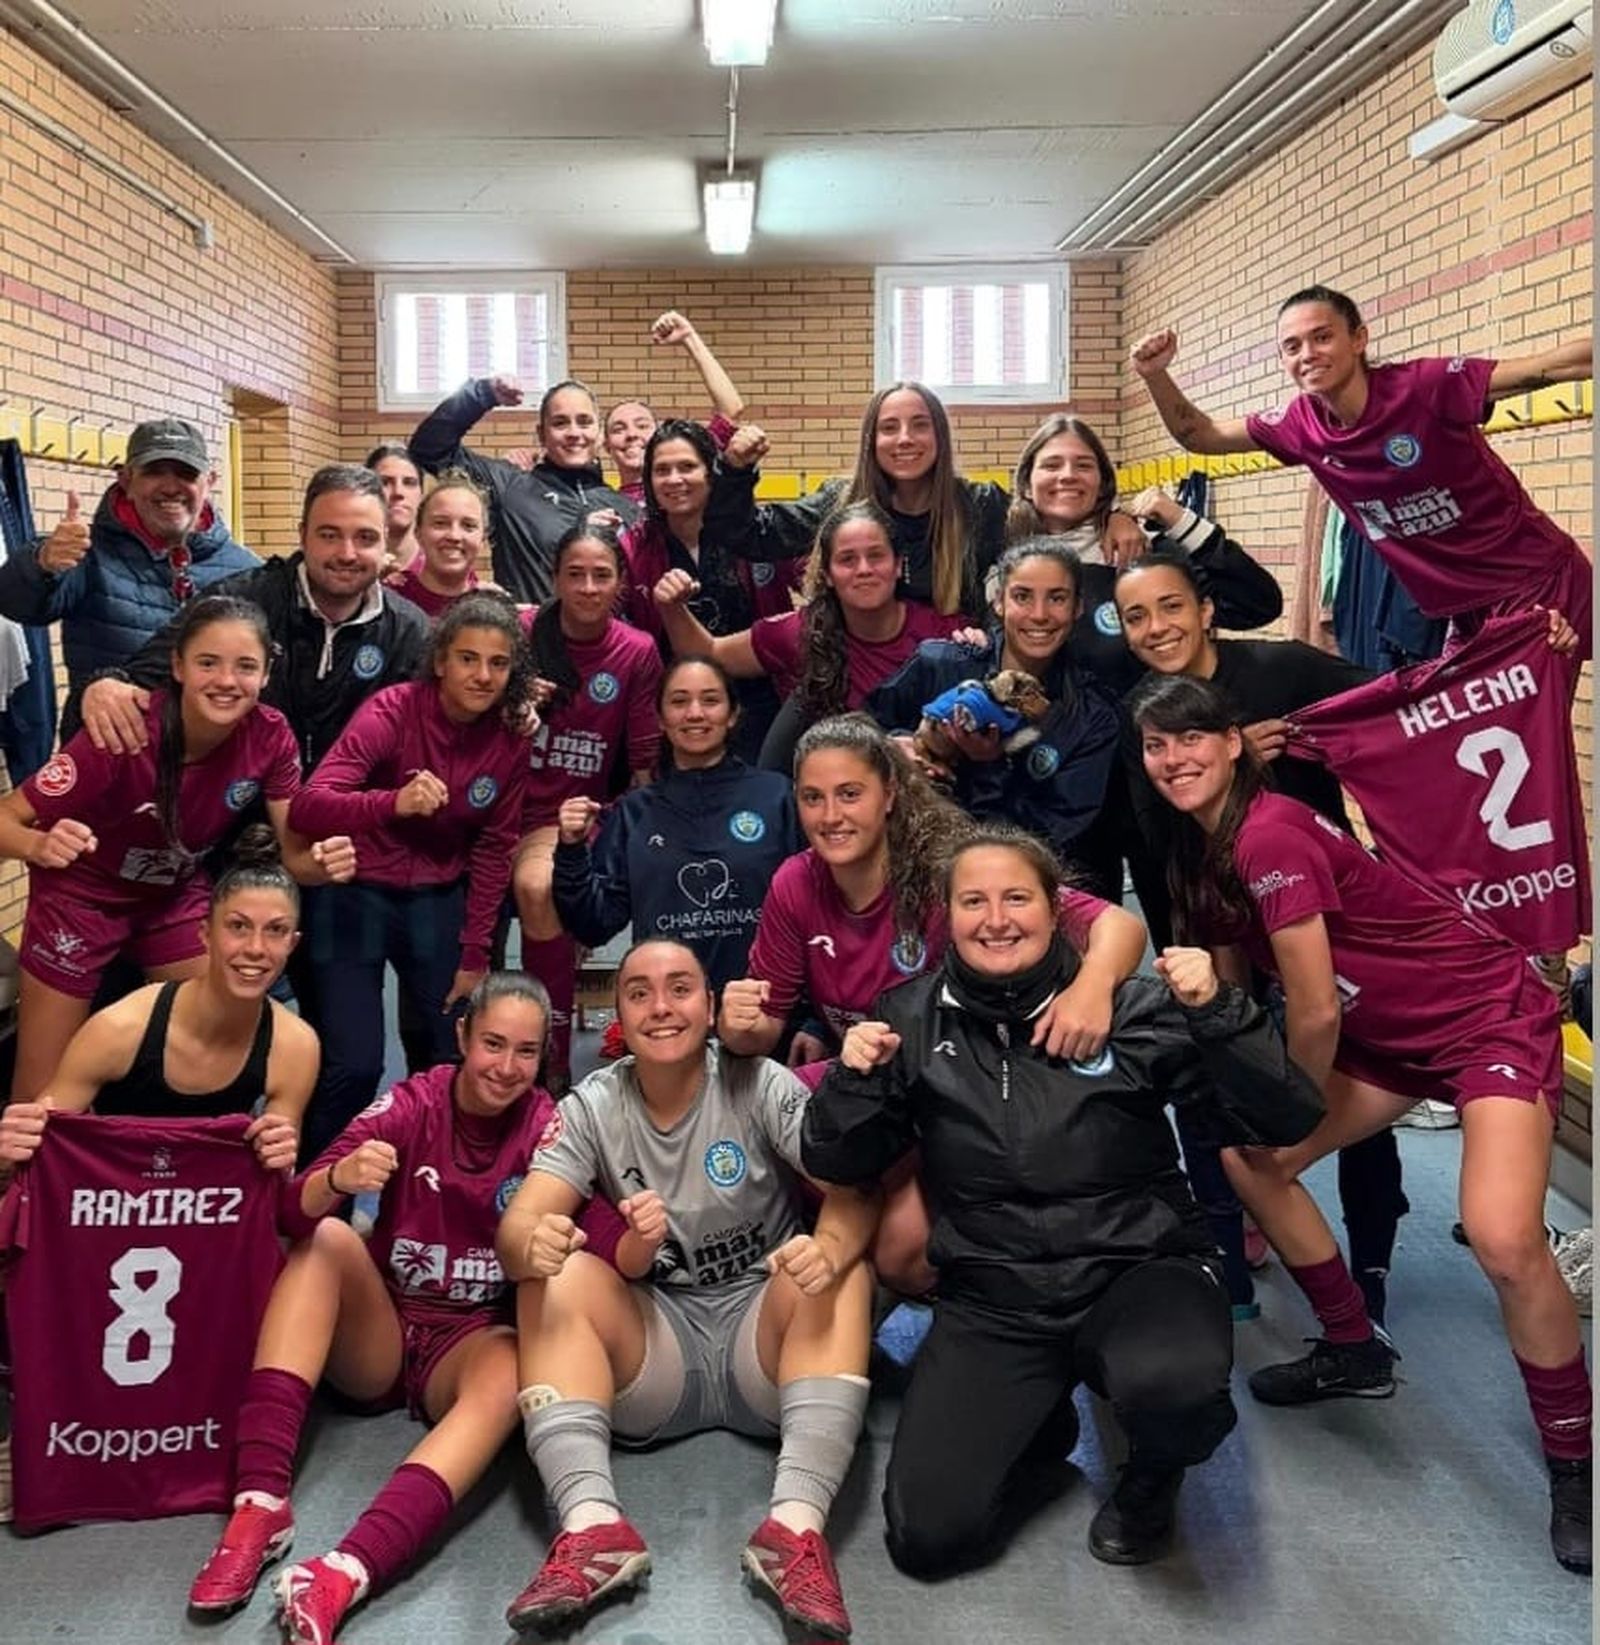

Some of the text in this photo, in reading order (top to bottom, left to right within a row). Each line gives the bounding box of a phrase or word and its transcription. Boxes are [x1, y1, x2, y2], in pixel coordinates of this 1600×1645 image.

[1392, 487, 1451, 521] mar
[1401, 498, 1463, 536] azul
[1396, 663, 1539, 738] HELENA
[547, 751, 603, 773] azul
[552, 735, 608, 755] mar
[1456, 725, 1555, 851] 2
[1456, 862, 1577, 914] Koppe
[656, 907, 764, 932] CHAFARINAS
[71, 1187, 244, 1227] RAMIREZ
[452, 1257, 504, 1282] ma
[102, 1246, 182, 1387] 8
[47, 1417, 222, 1462] Koppert
